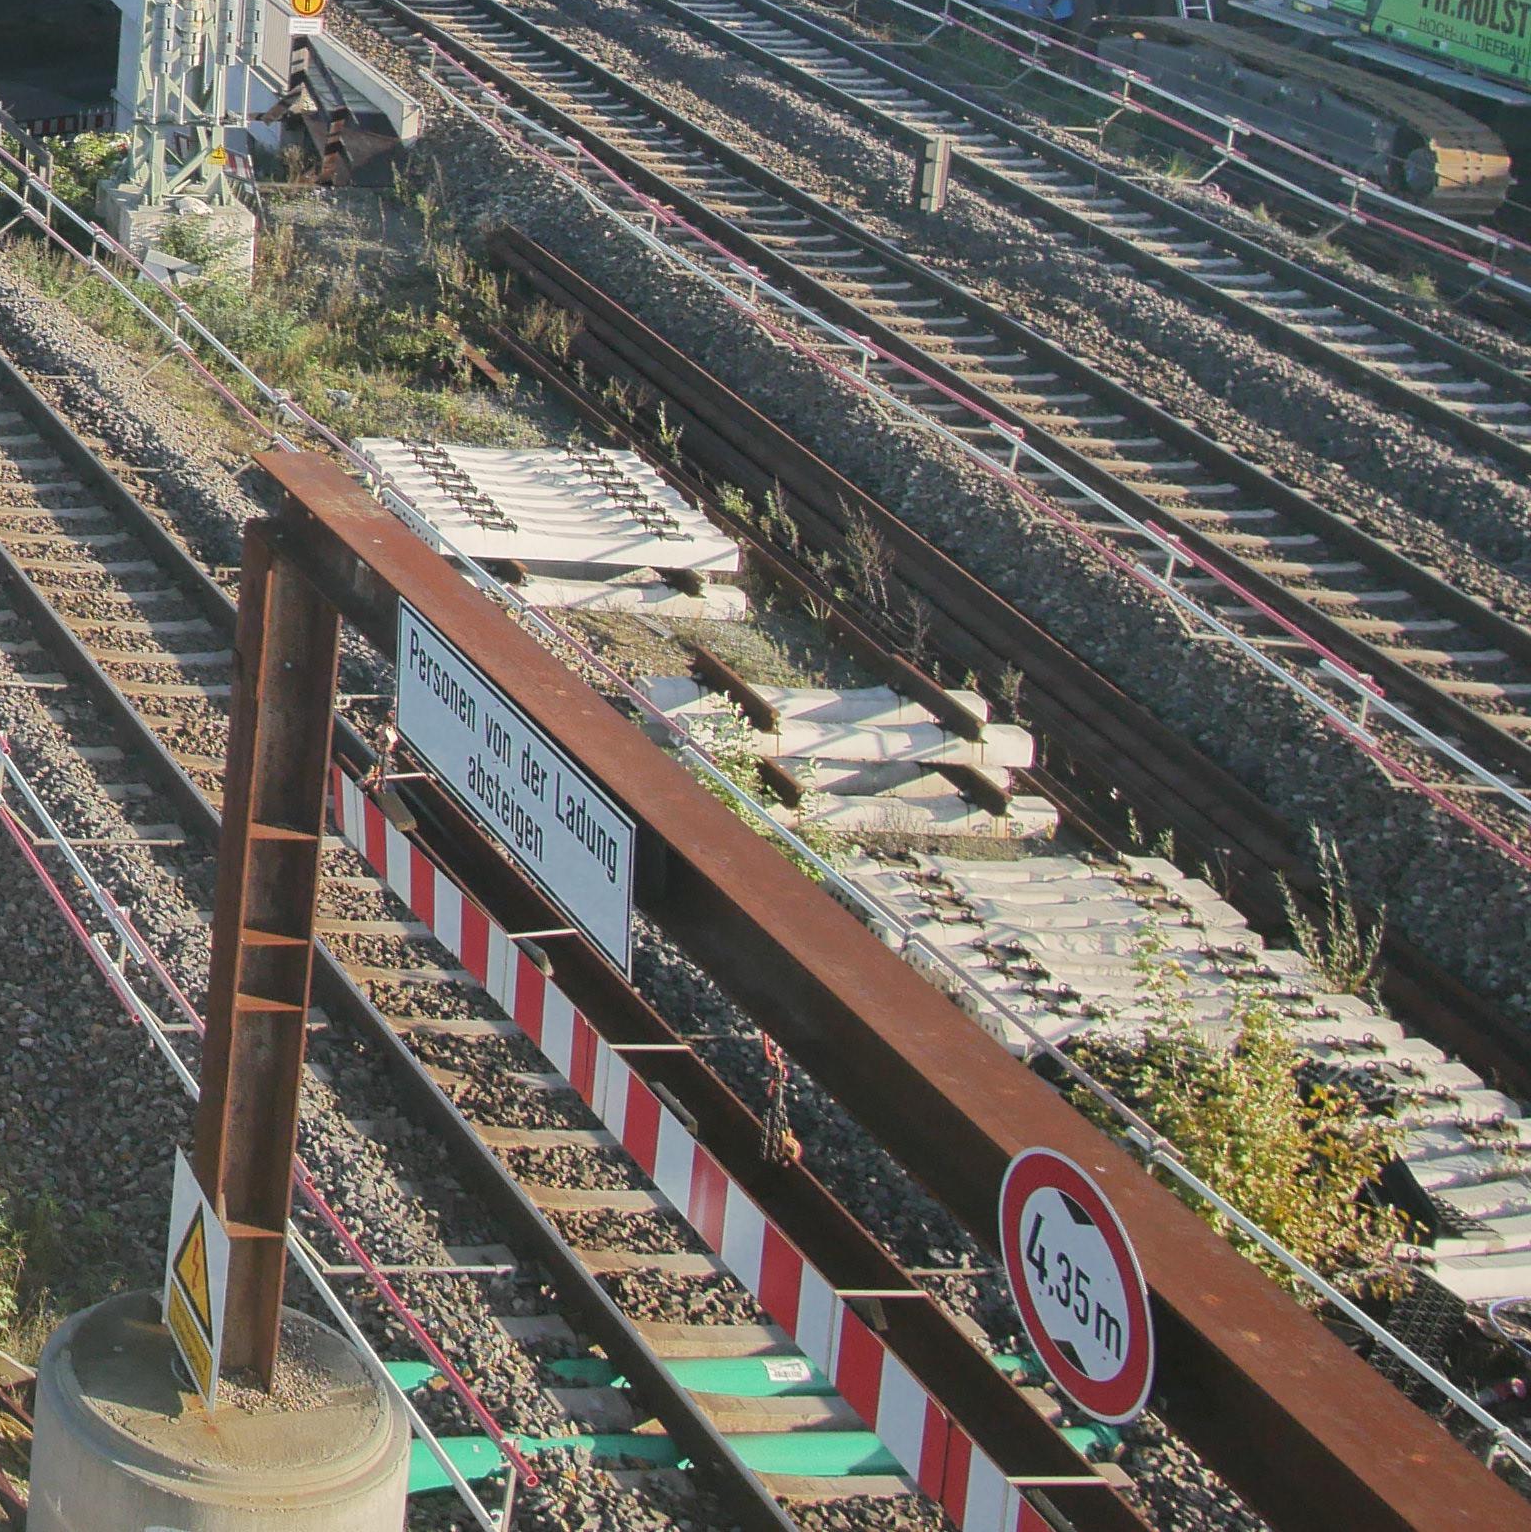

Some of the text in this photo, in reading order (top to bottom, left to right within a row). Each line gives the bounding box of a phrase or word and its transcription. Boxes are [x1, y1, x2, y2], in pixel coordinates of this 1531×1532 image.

[409, 626, 619, 885] Personen von der Ladung
[468, 752, 545, 863] absteigen
[1026, 1212, 1122, 1361] 4,35 m
